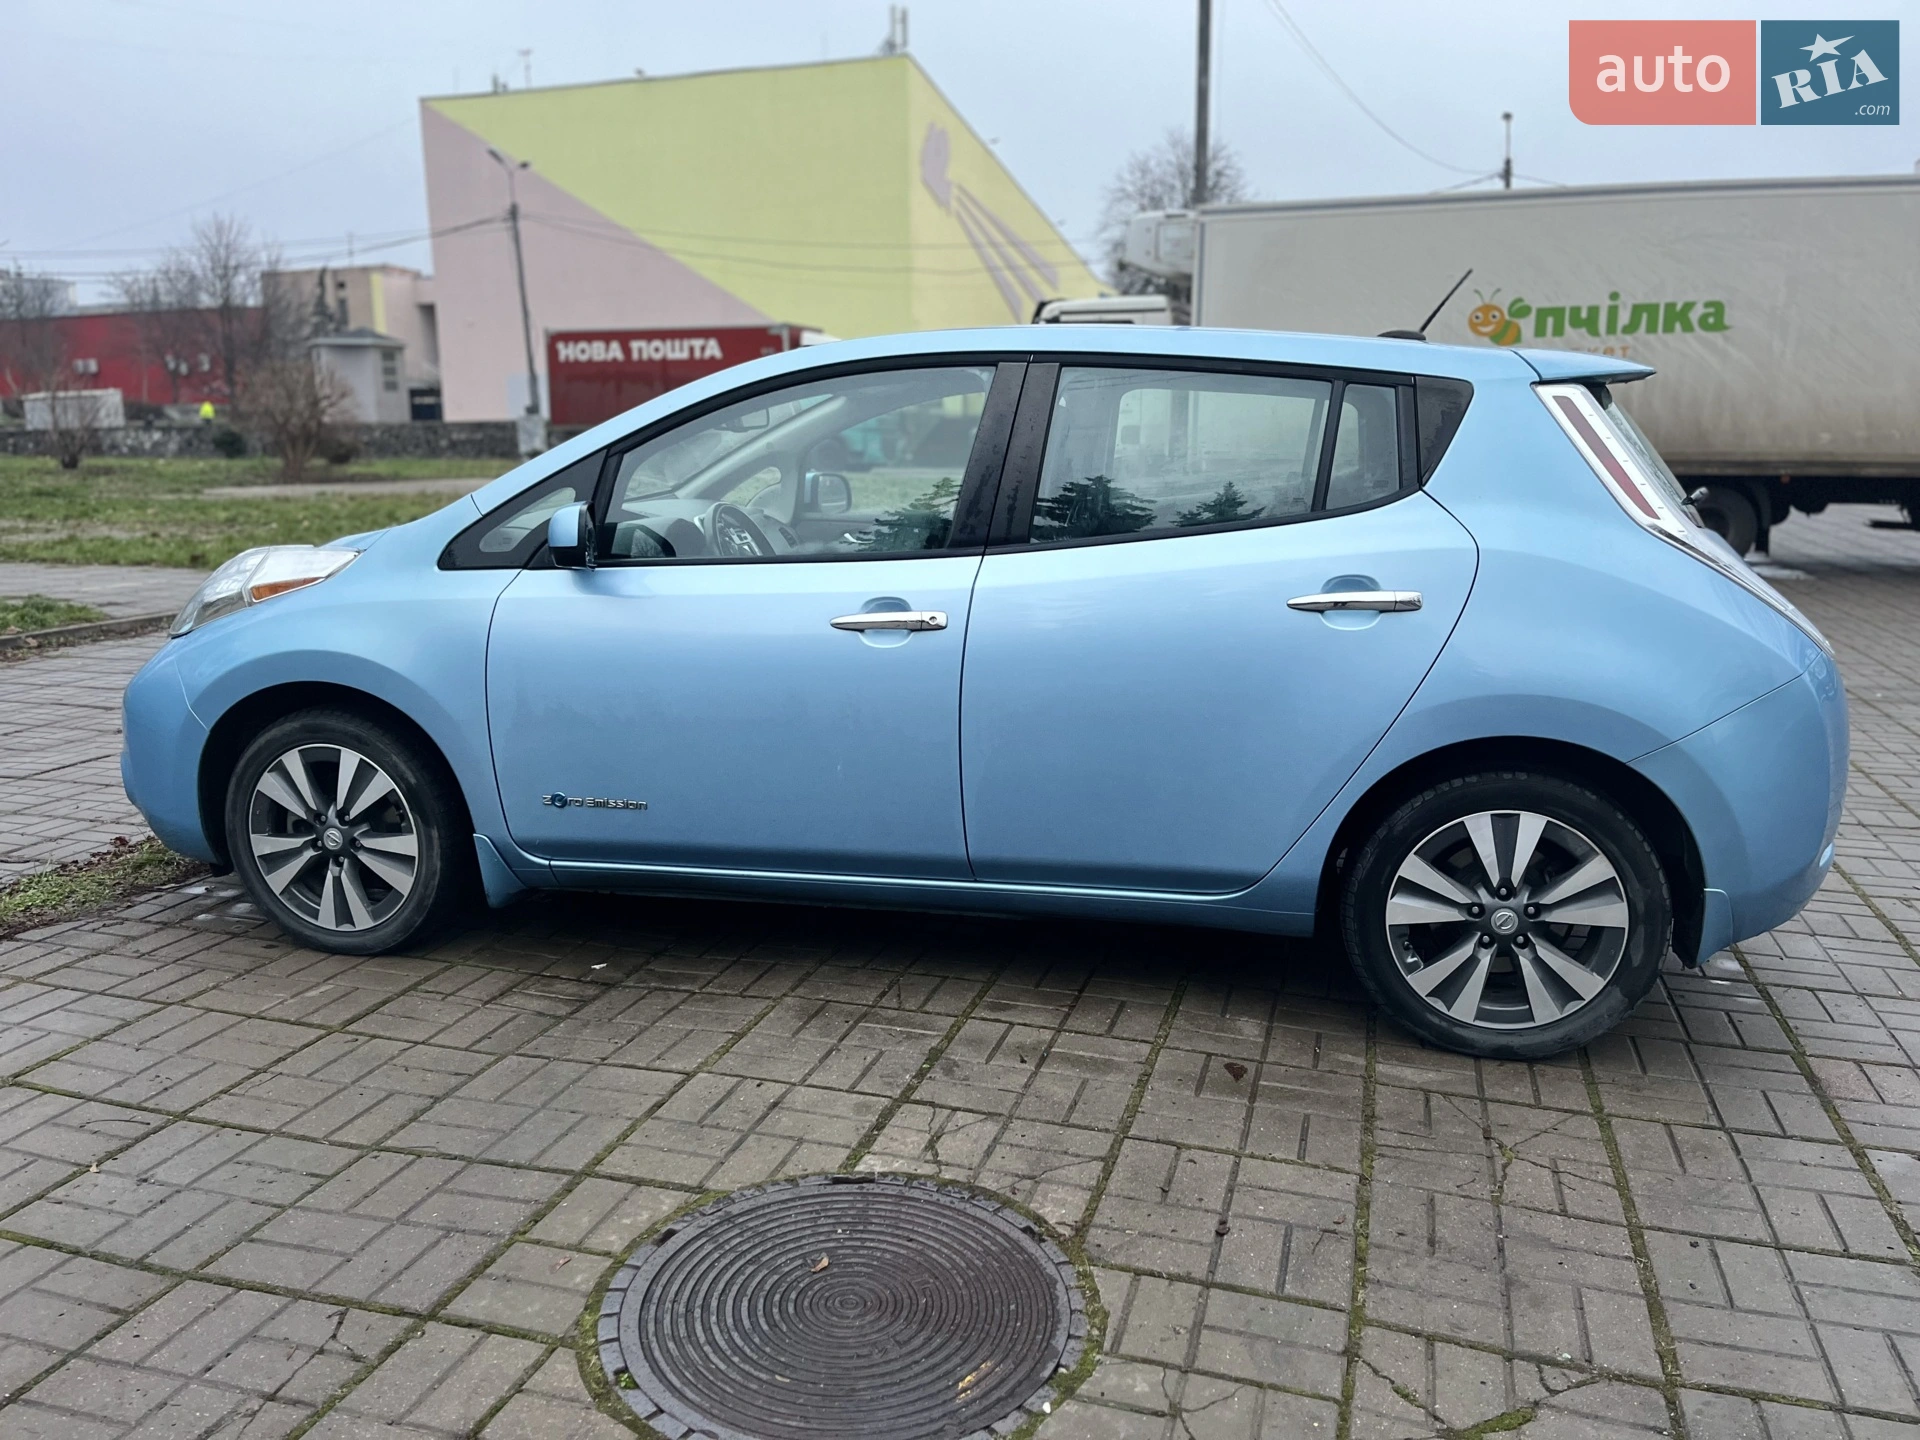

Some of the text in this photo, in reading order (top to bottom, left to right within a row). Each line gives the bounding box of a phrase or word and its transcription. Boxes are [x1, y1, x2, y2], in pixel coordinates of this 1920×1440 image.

[1534, 291, 1731, 338] пчілка
[555, 337, 723, 363] НОВА ПОШТА
